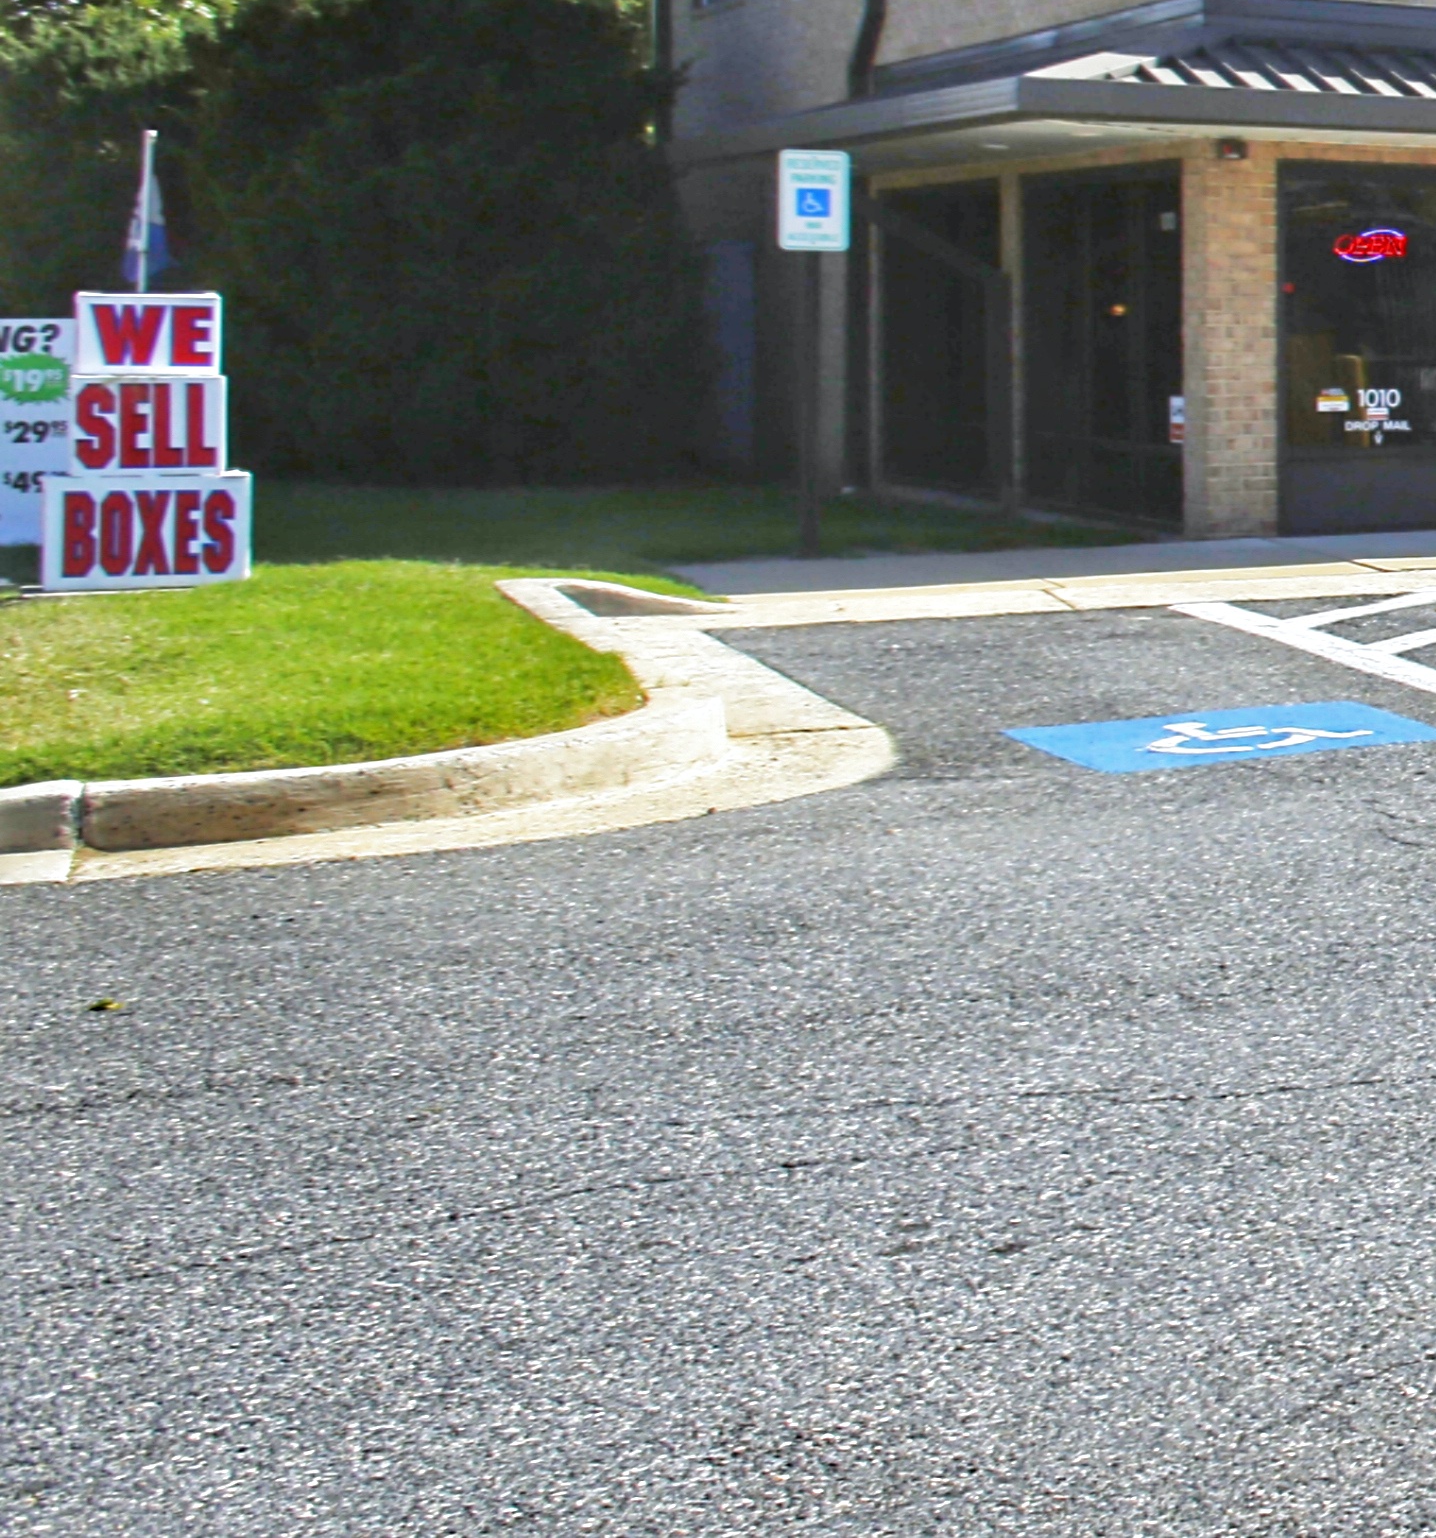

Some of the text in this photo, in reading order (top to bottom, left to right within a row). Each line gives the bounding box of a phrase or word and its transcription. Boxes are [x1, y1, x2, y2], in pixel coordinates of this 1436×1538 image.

[1333, 234, 1407, 258] OPEN
[91, 303, 214, 367] WE
[1357, 388, 1402, 408] 1010
[75, 383, 218, 469] SELL
[1344, 420, 1413, 432] DROP MAIL
[62, 489, 236, 578] BOXES
